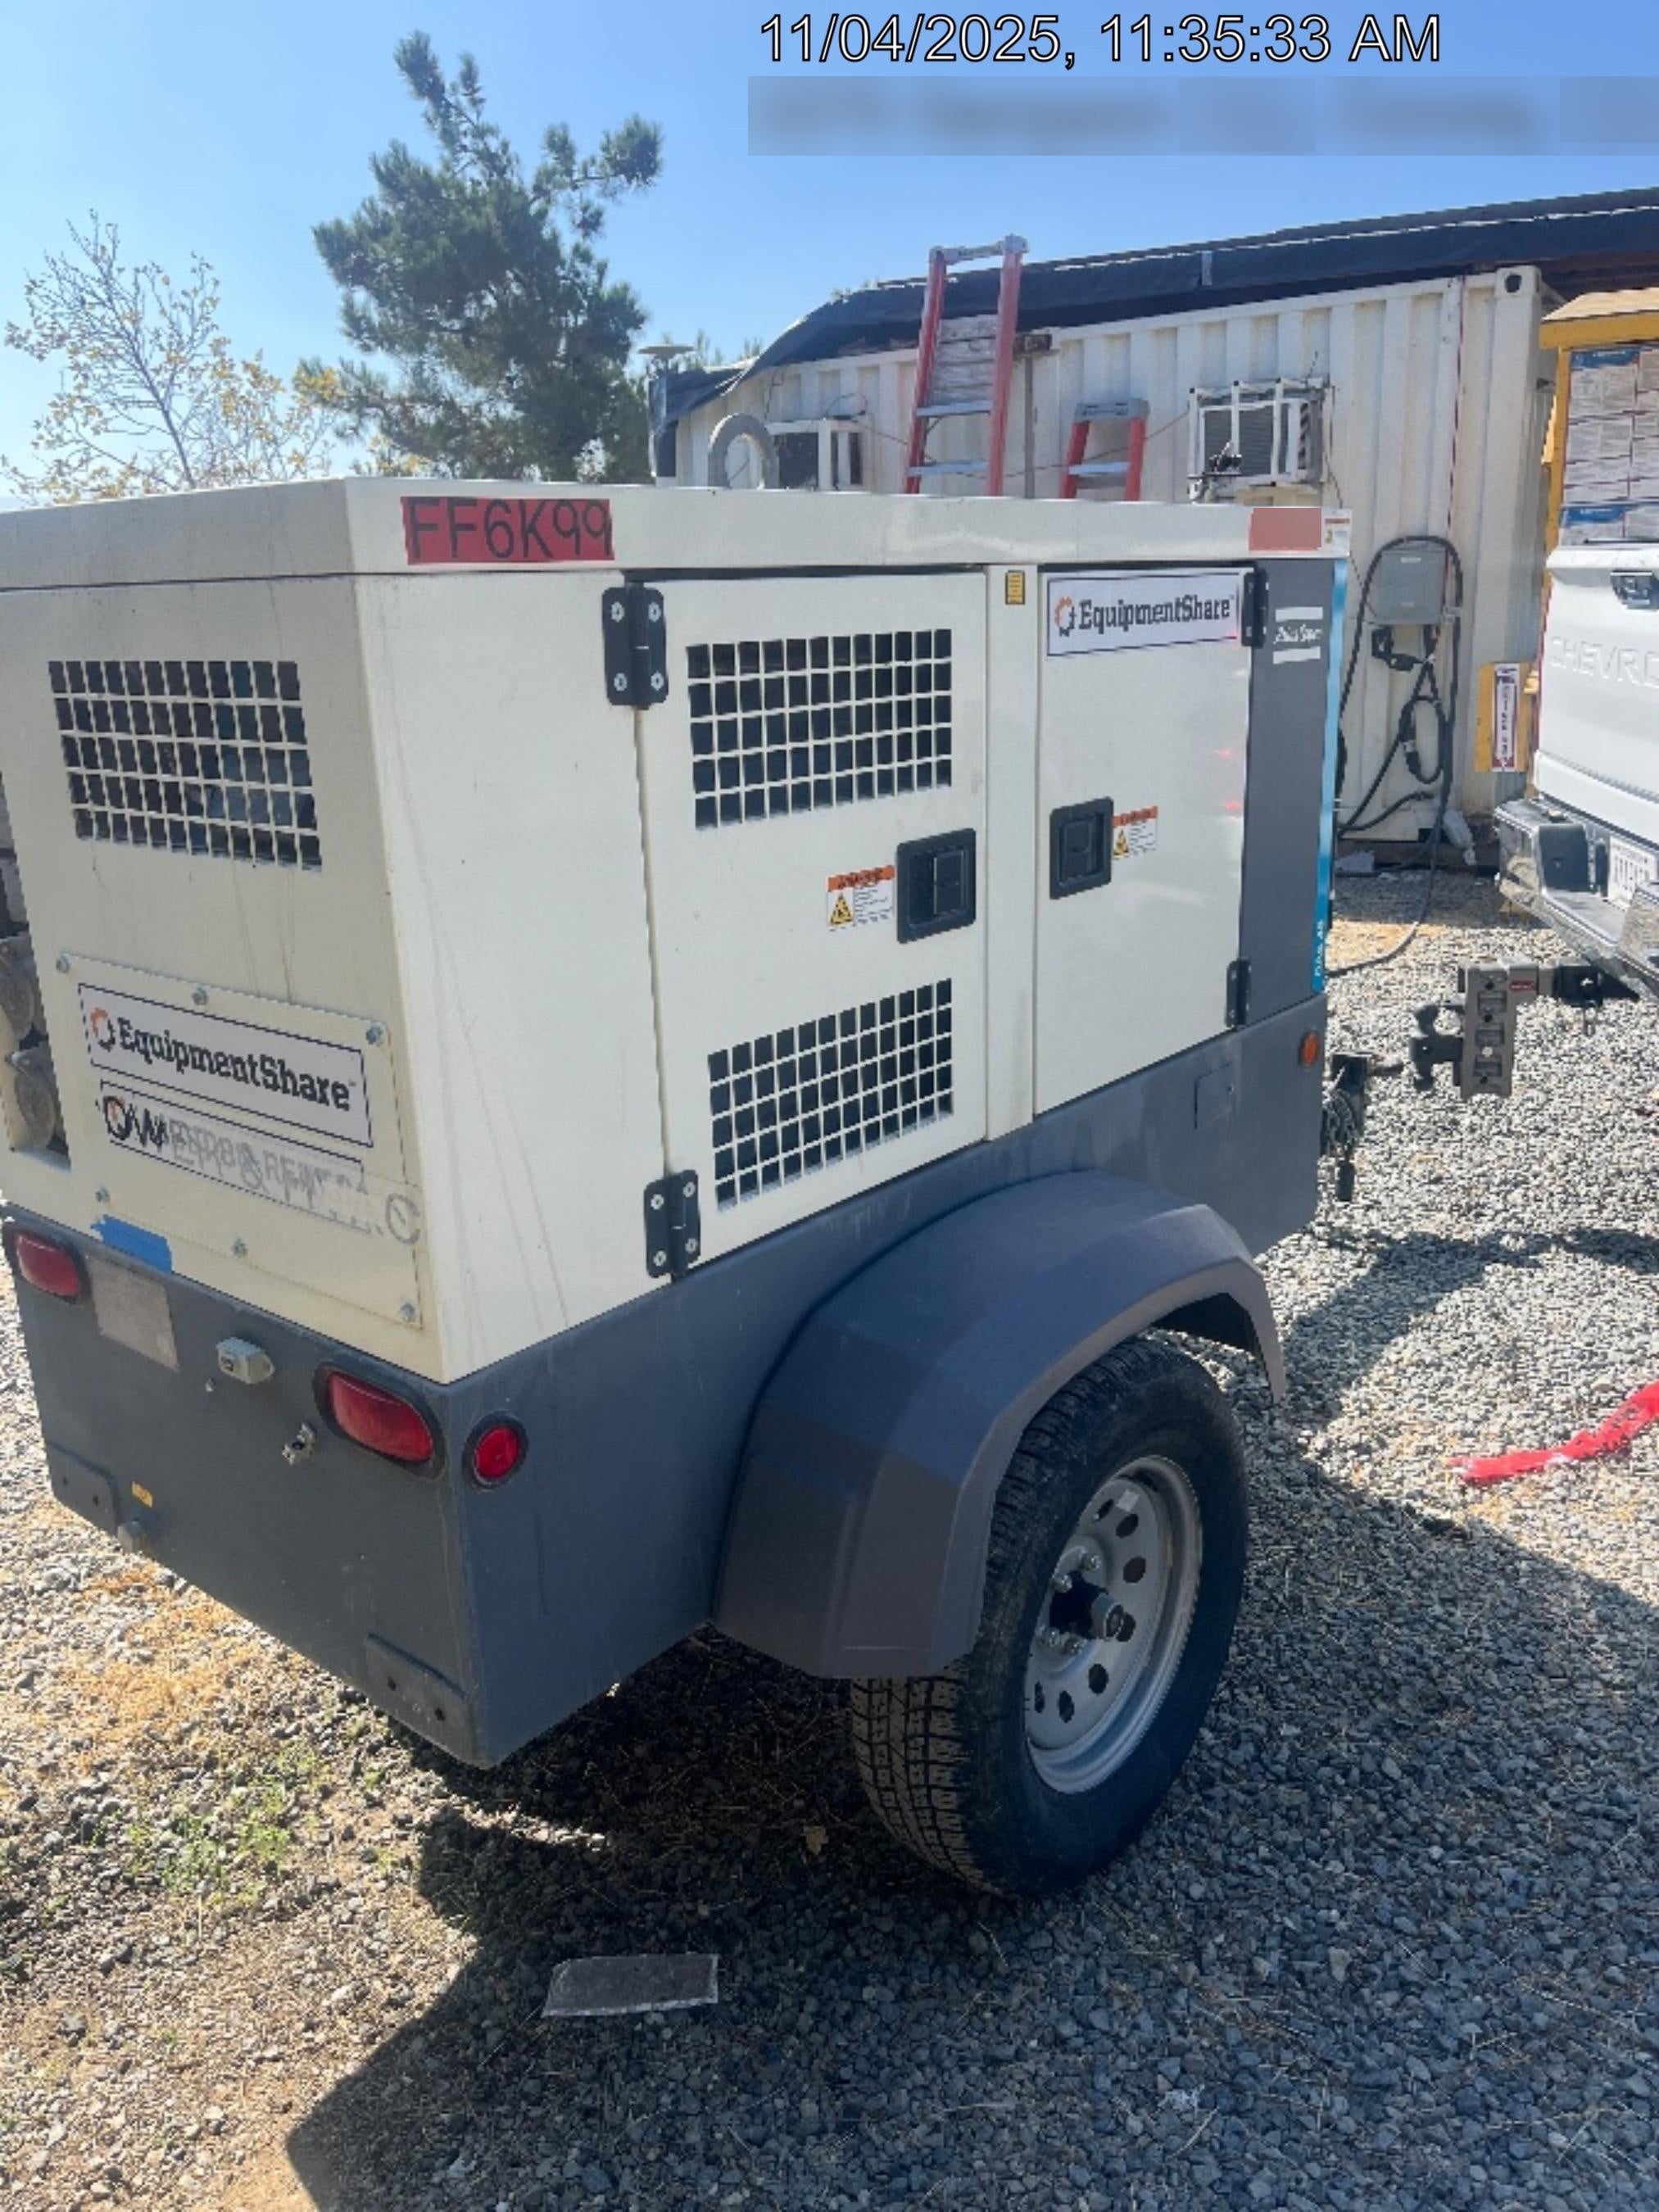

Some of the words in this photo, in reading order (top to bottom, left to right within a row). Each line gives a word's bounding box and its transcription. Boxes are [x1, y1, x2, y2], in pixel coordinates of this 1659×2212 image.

[408, 496, 613, 559] FF6K99
[1078, 595, 1231, 635] EquipmentShare
[117, 1017, 351, 1112] EquipmentShare
